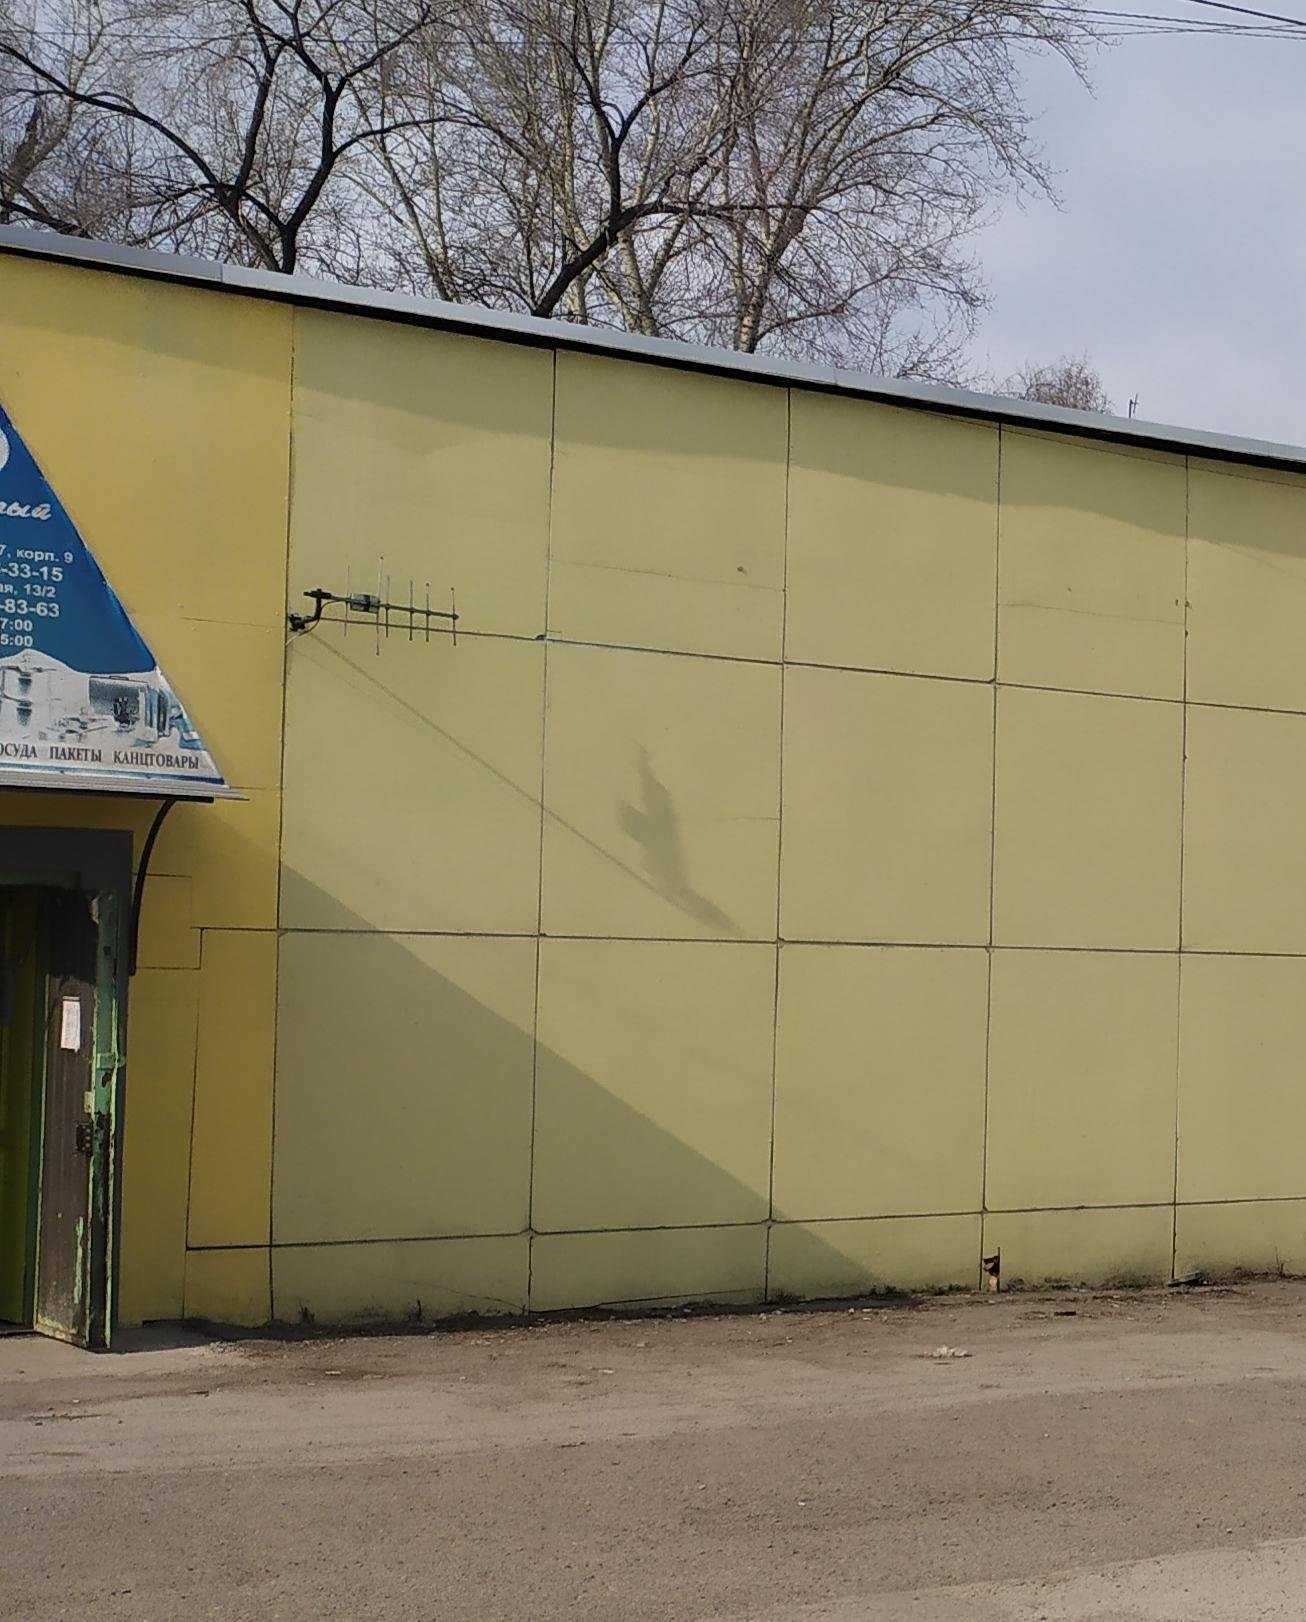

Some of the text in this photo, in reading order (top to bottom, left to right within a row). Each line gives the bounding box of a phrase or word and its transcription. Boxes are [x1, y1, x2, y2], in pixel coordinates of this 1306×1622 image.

[16, 548, 60, 562] корп.
[63, 551, 74, 564] 9
[24, 583, 56, 598] 13/2
[50, 745, 102, 763] ПАКЕТЫ
[114, 750, 200, 770] КАНЦТОВАРЫ
